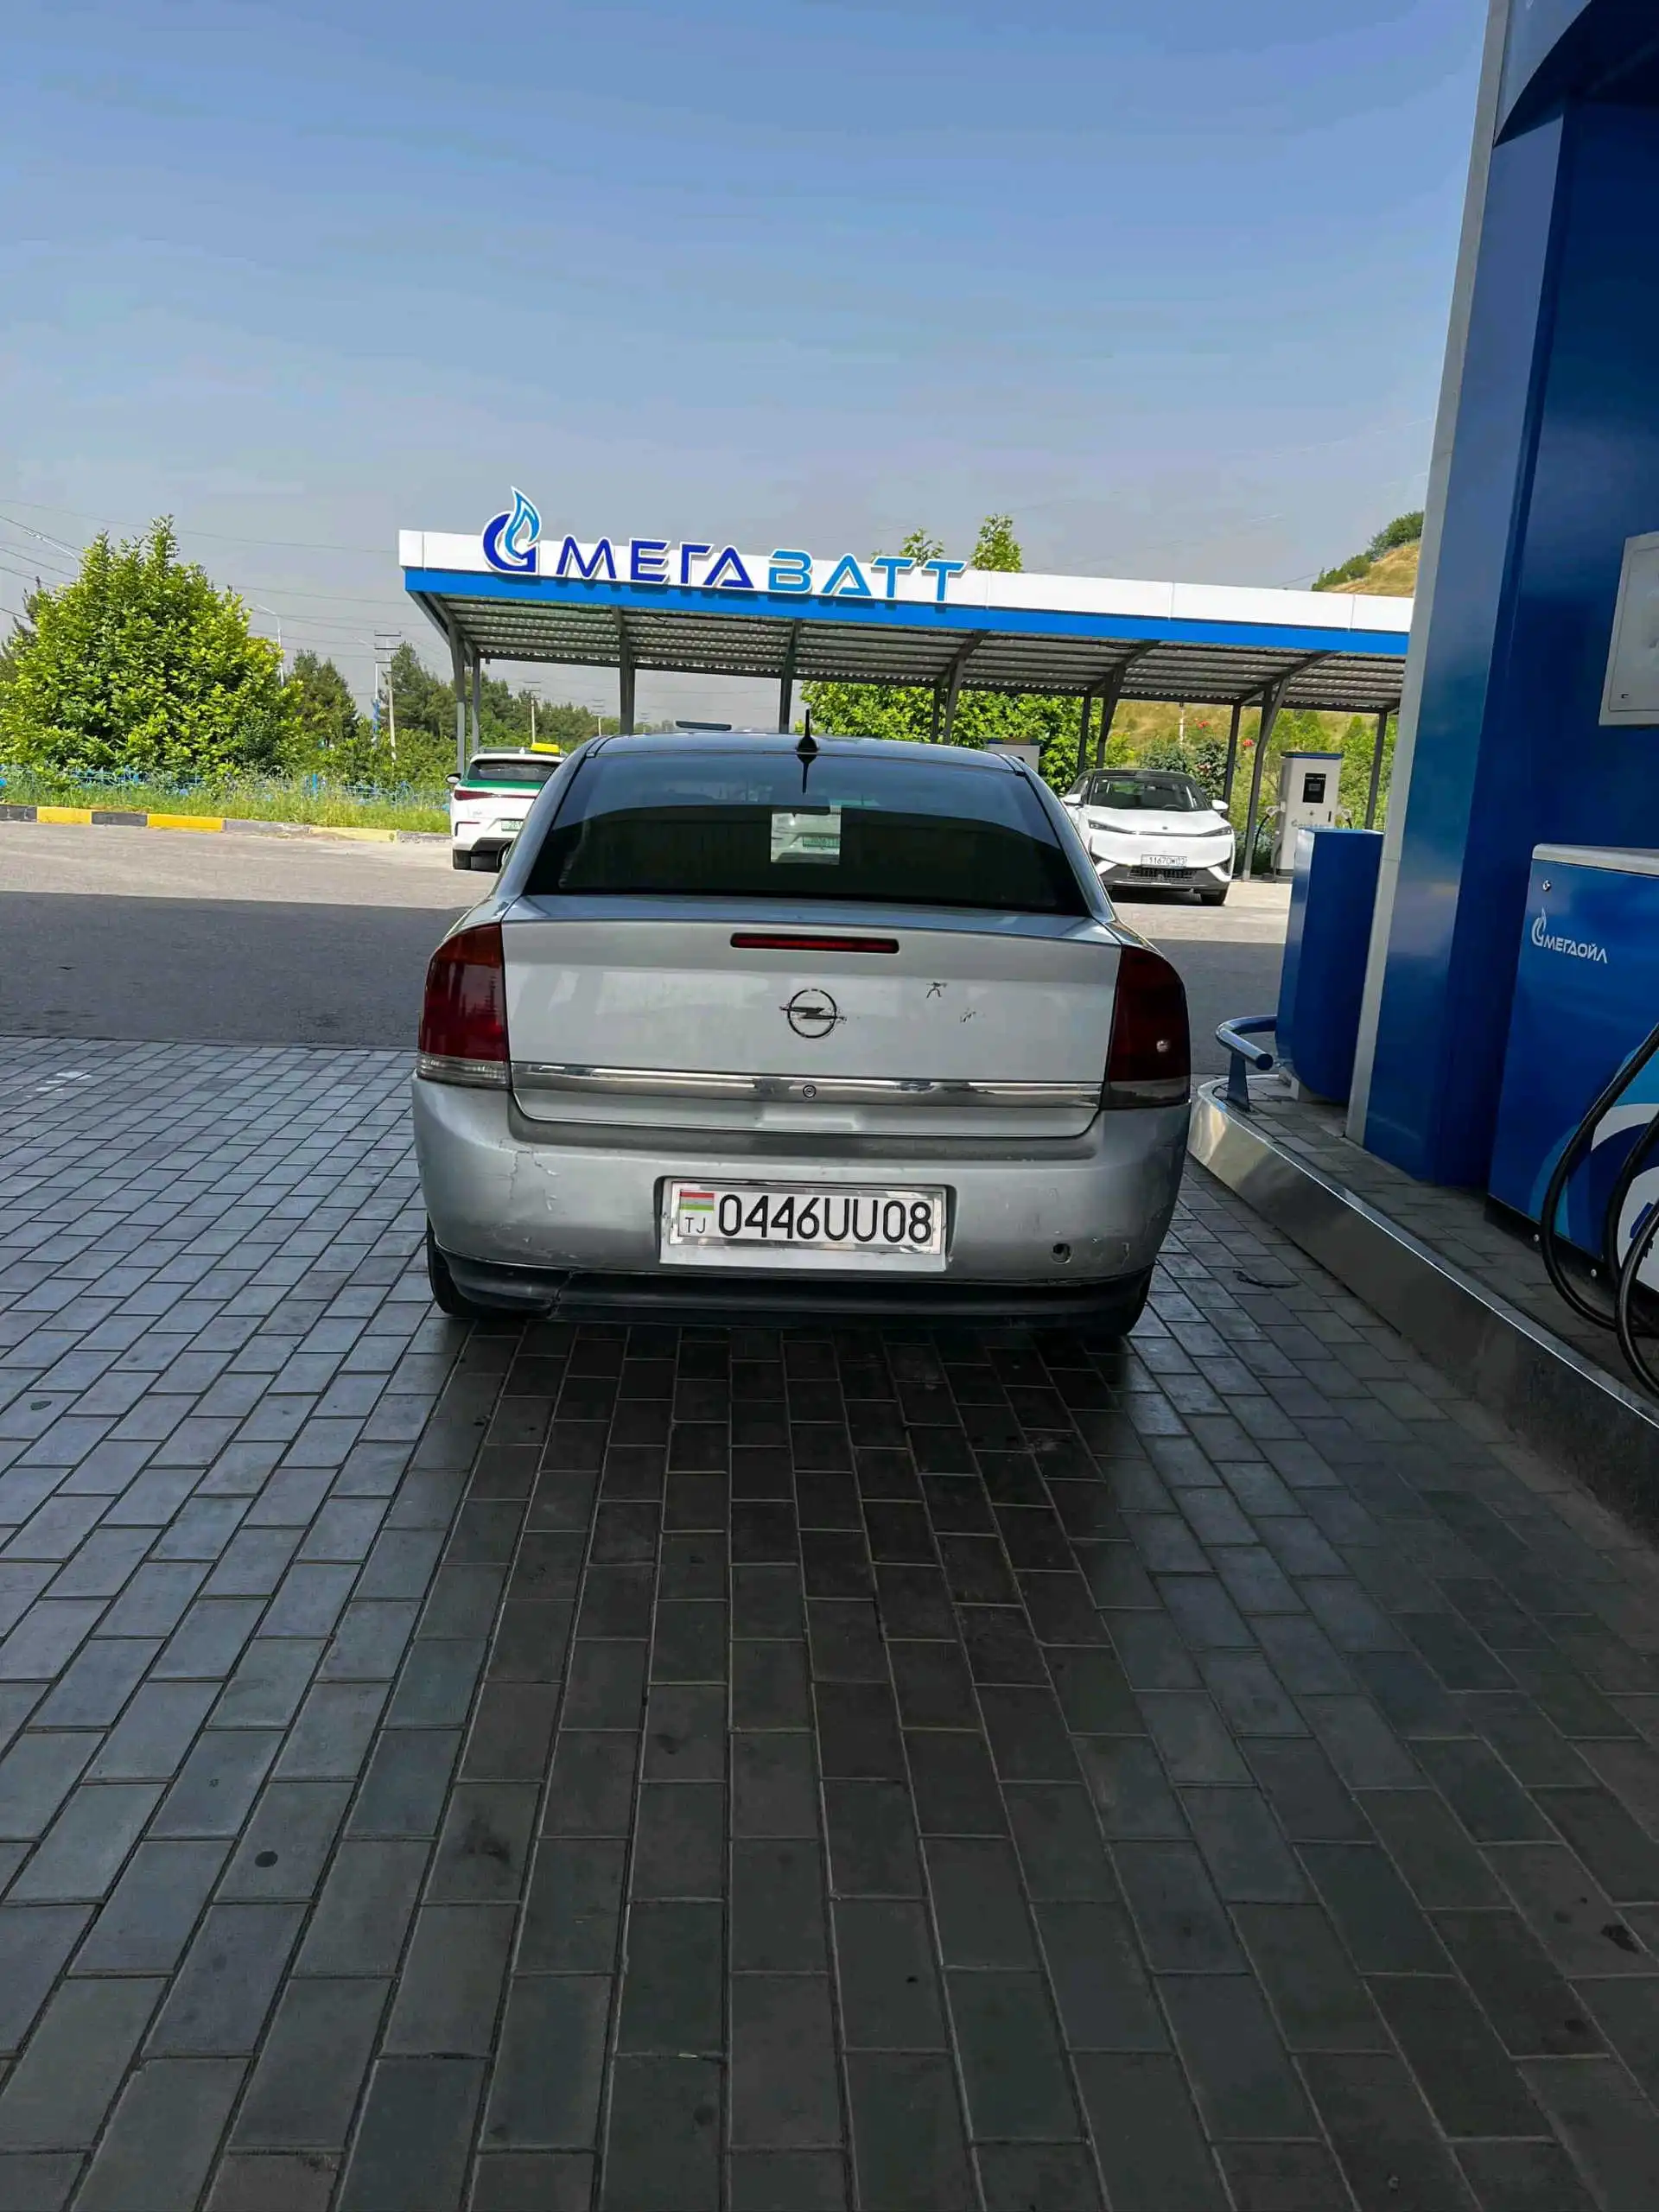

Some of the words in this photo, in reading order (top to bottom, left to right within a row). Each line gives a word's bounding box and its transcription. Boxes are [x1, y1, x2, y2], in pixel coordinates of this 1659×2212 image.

[556, 535, 968, 602] МЕГАВАТТ
[1543, 935, 1608, 963] МЕГАОЙЛ
[685, 1217, 706, 1234] TJ
[719, 1194, 932, 1244] 0446UU08
